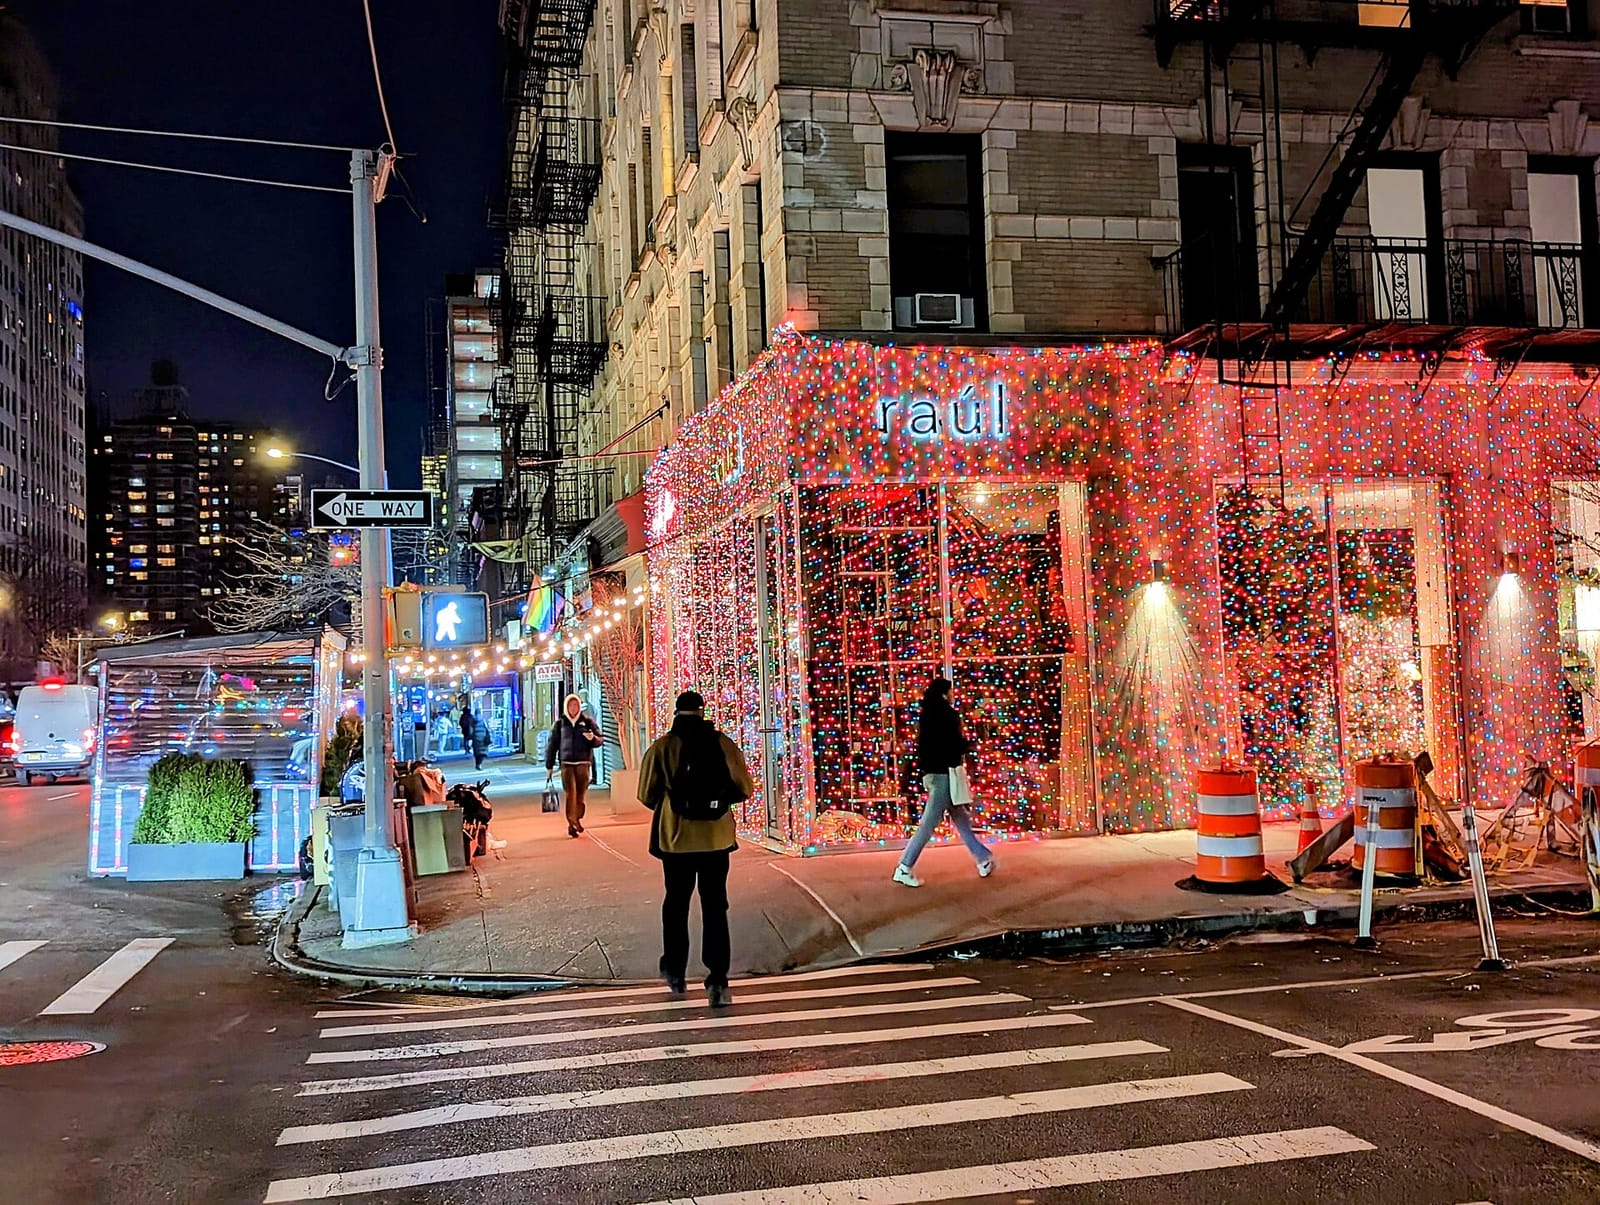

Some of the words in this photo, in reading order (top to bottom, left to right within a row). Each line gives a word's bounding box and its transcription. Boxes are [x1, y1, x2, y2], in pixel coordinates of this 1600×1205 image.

[878, 384, 1005, 435] raúl
[331, 502, 365, 516] ONE
[381, 502, 416, 516] WAY
[538, 665, 561, 674] ATM
